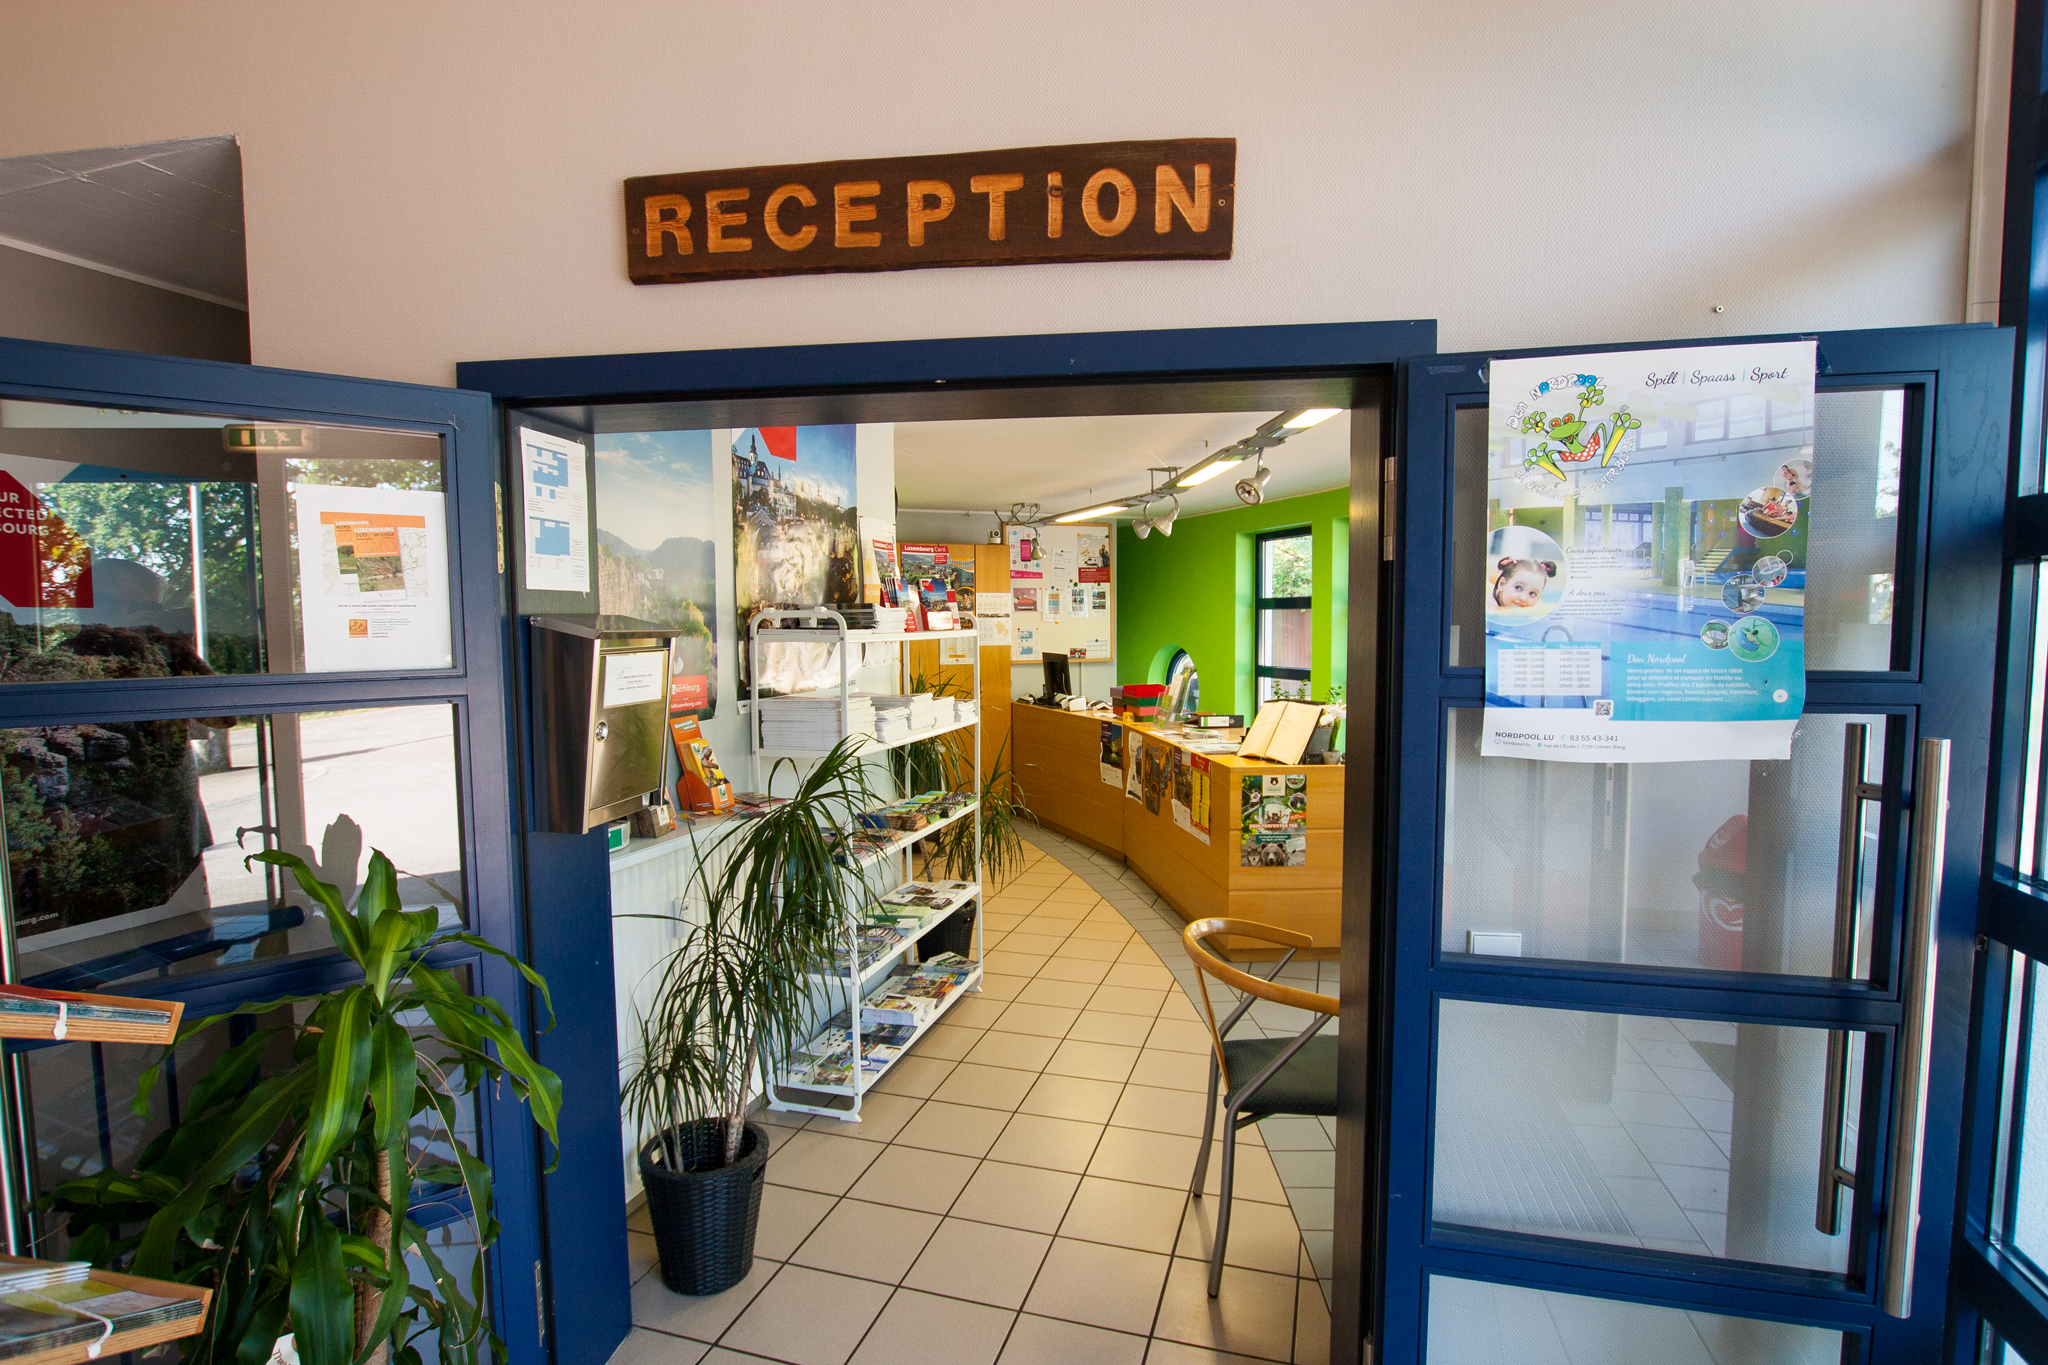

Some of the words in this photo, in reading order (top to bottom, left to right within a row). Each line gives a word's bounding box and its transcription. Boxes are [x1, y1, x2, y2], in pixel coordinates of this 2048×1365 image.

[644, 162, 1212, 257] RECEPTION
[1645, 371, 1678, 389] Spill
[1690, 370, 1736, 387] Spaass
[1750, 366, 1788, 384] Sport
[1495, 731, 1554, 741] NORDPOOL.LU
